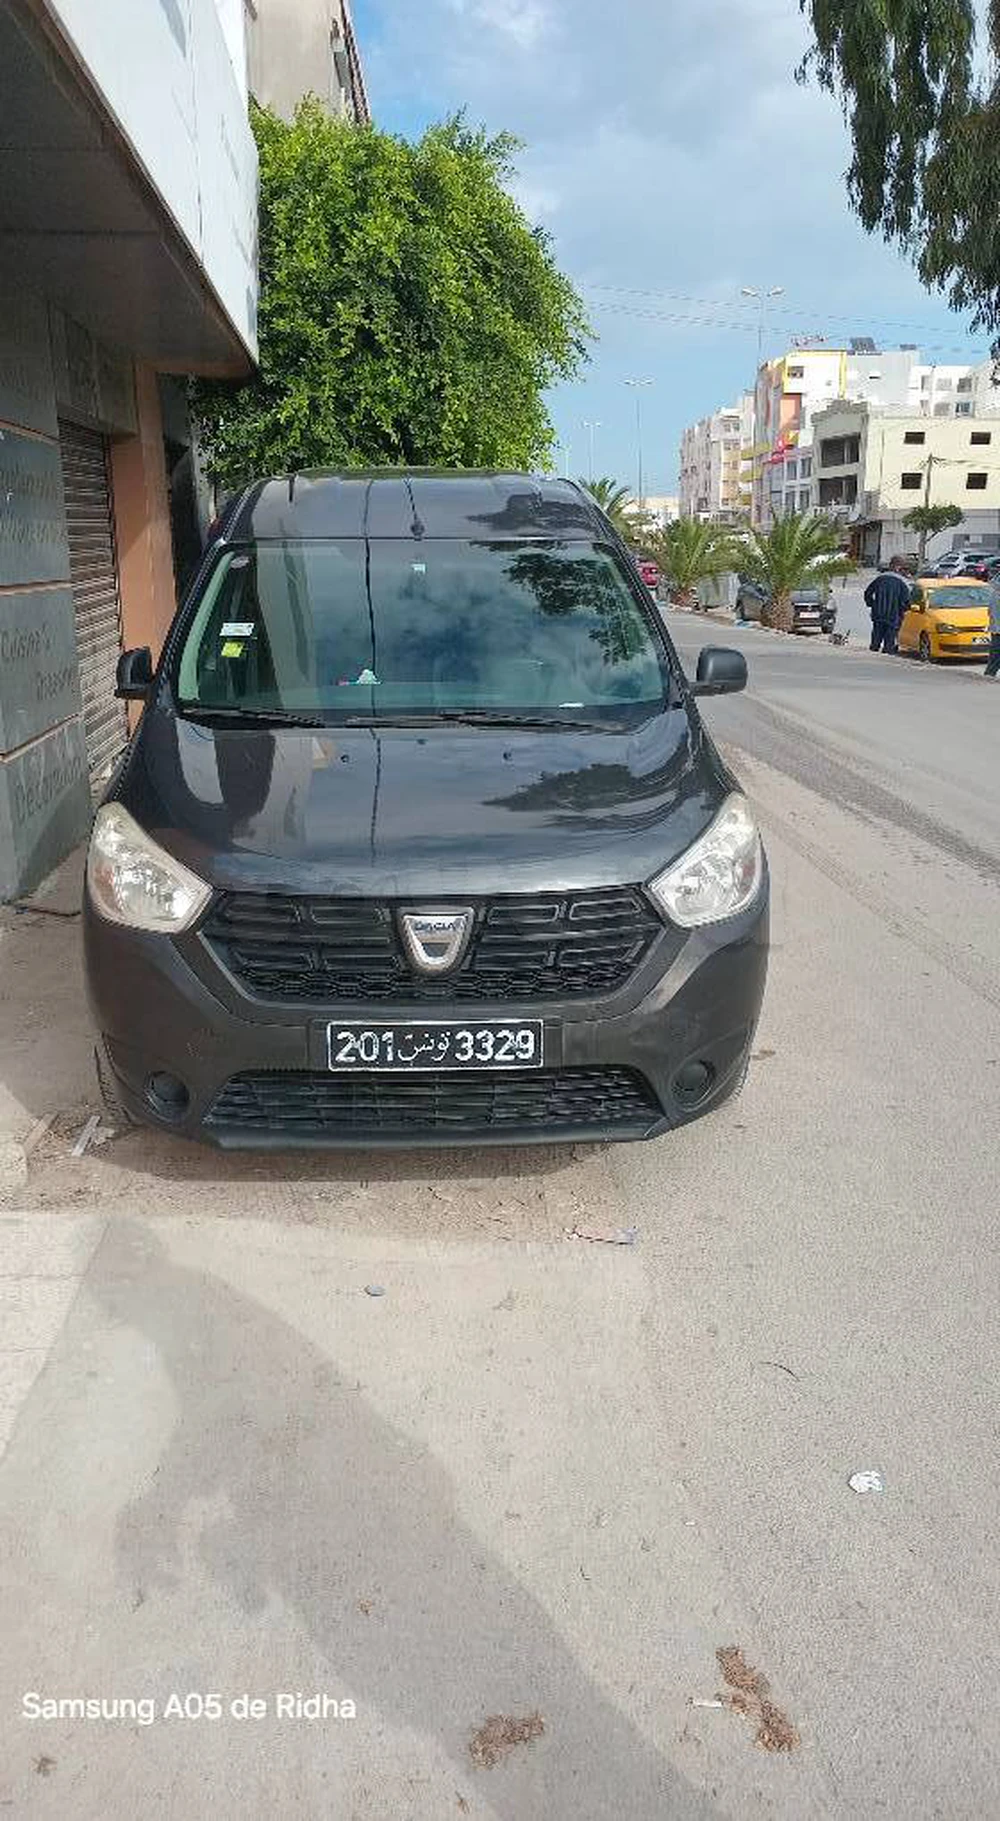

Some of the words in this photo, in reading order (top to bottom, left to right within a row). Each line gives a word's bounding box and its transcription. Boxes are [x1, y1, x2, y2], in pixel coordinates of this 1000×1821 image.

[334, 1030, 394, 1062] 201
[398, 1031, 451, 1062] تونس
[454, 1029, 536, 1061] 3329
